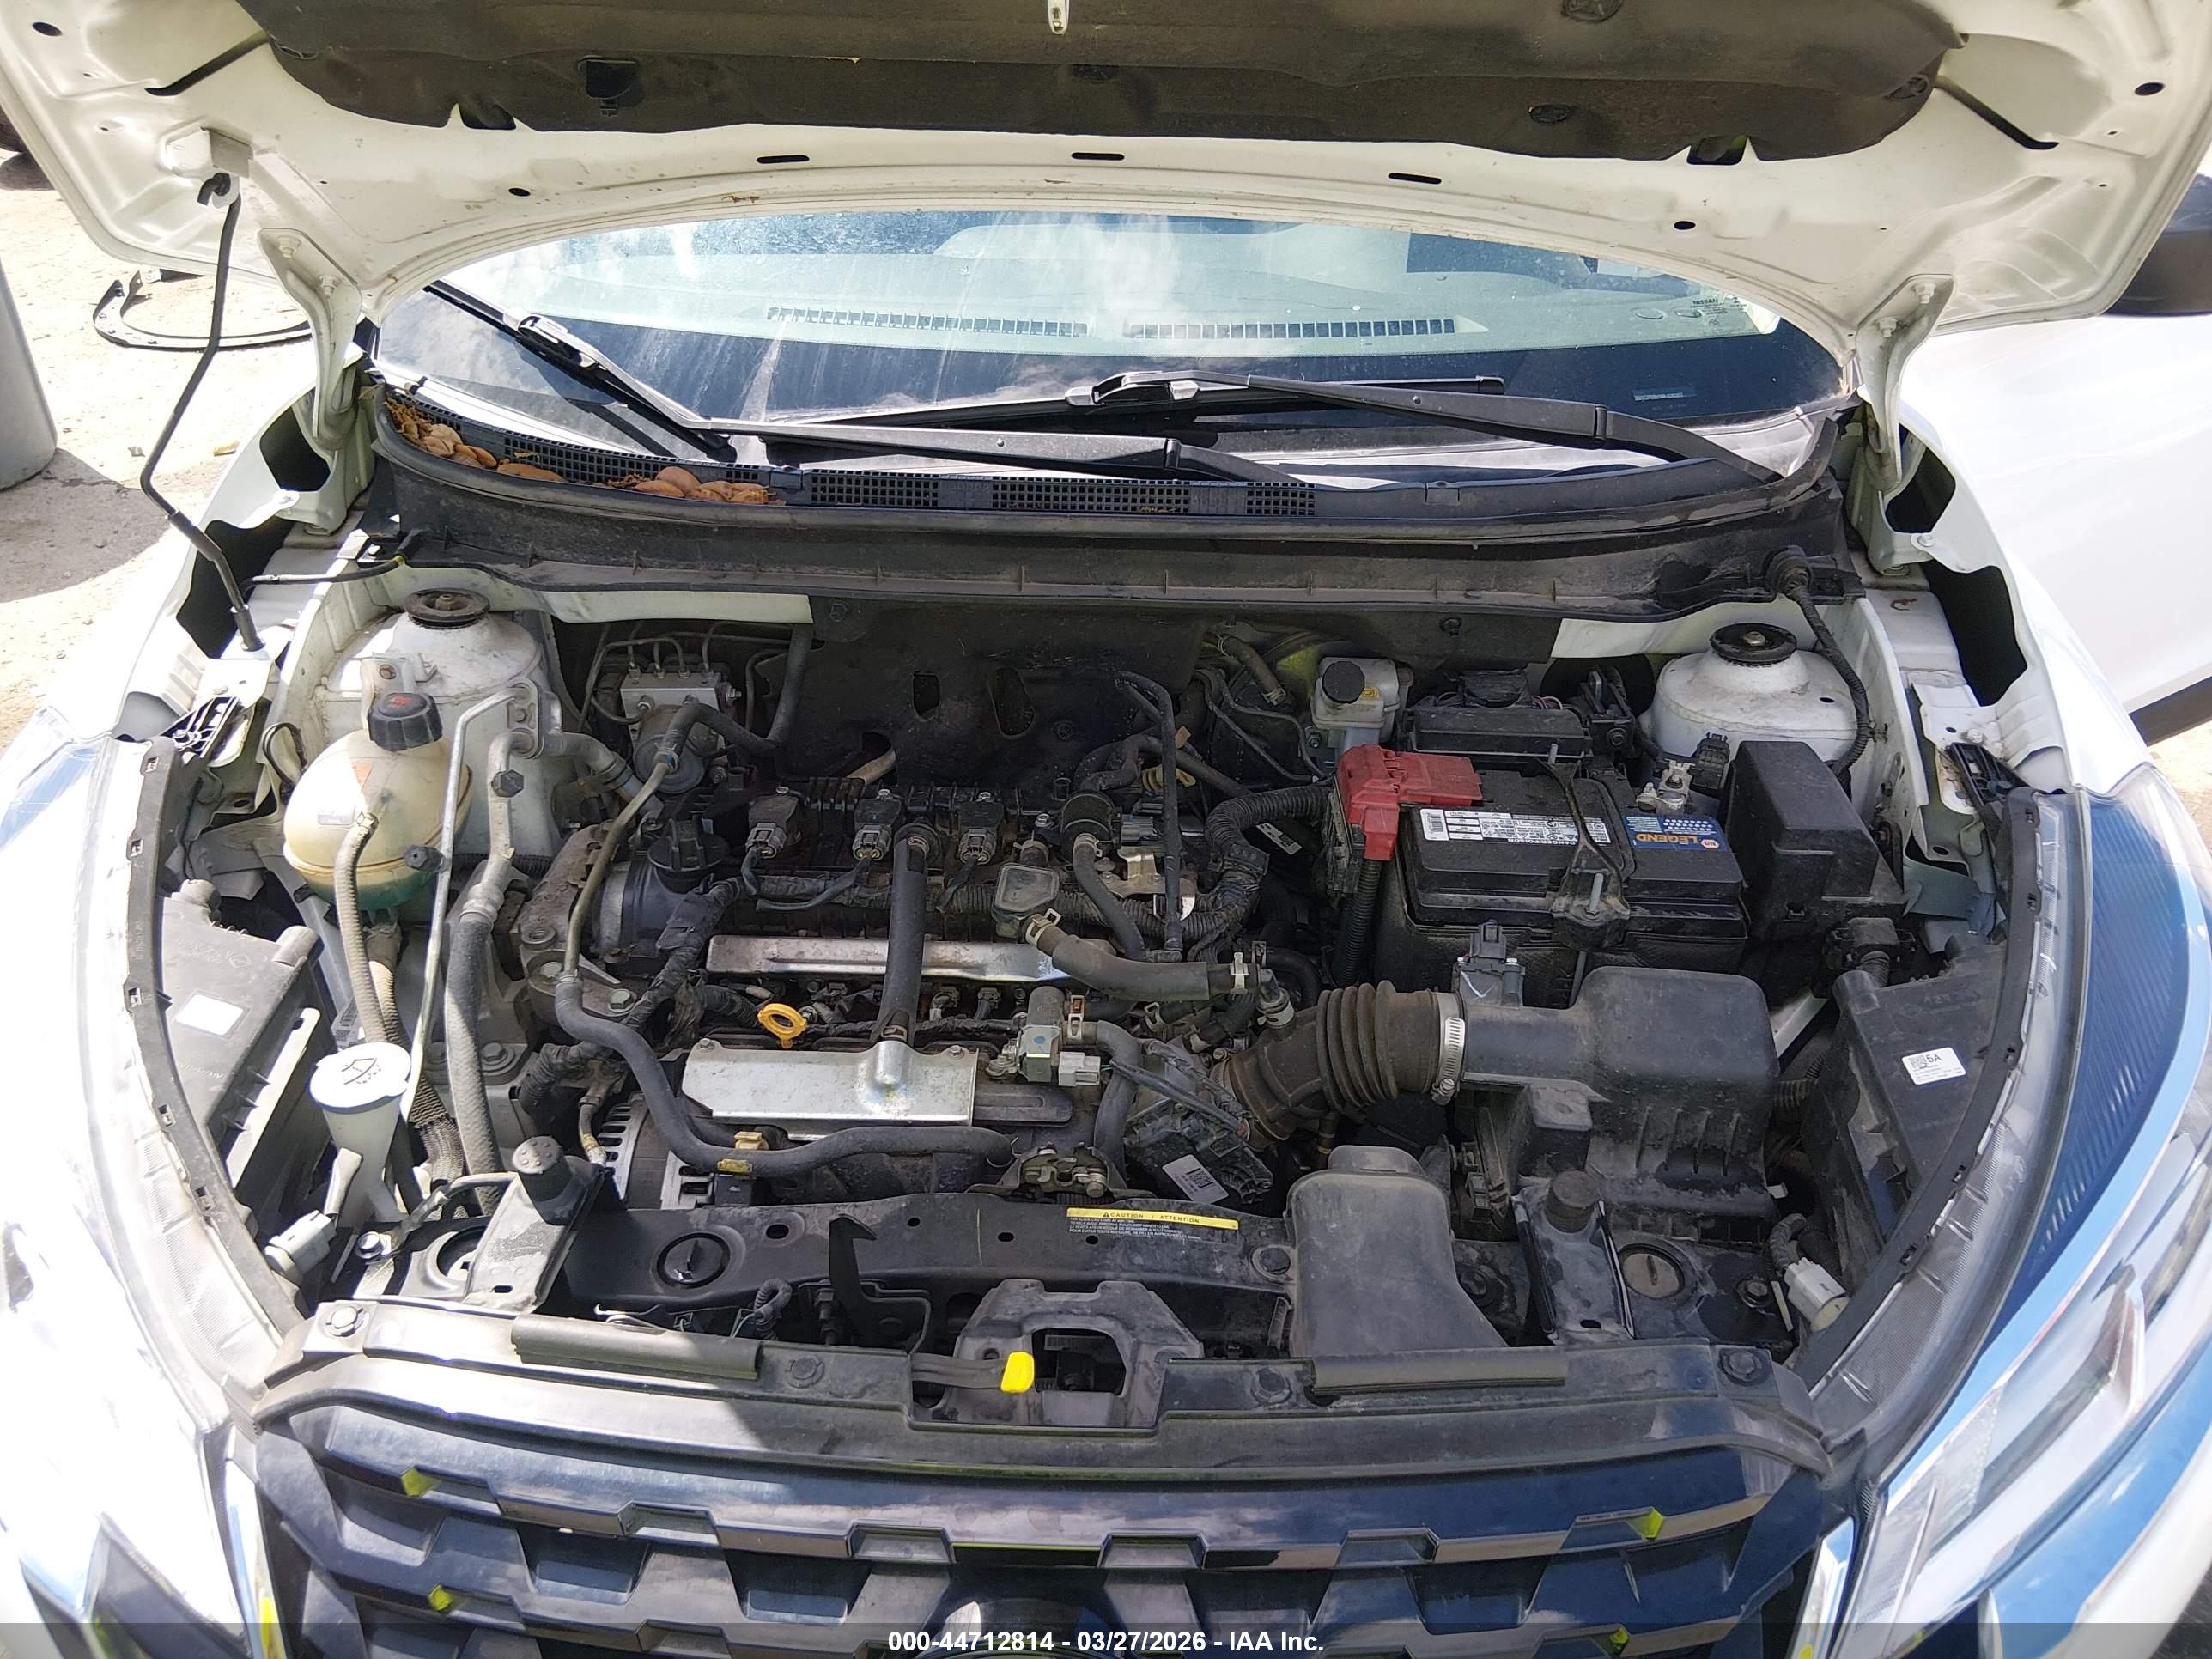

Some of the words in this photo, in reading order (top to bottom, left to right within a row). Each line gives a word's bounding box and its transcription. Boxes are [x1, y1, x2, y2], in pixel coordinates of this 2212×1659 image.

[1635, 833, 1698, 844] LEGEND
[1925, 1053, 1942, 1063] 5A
[1159, 1215, 1200, 1224] ATTENTION
